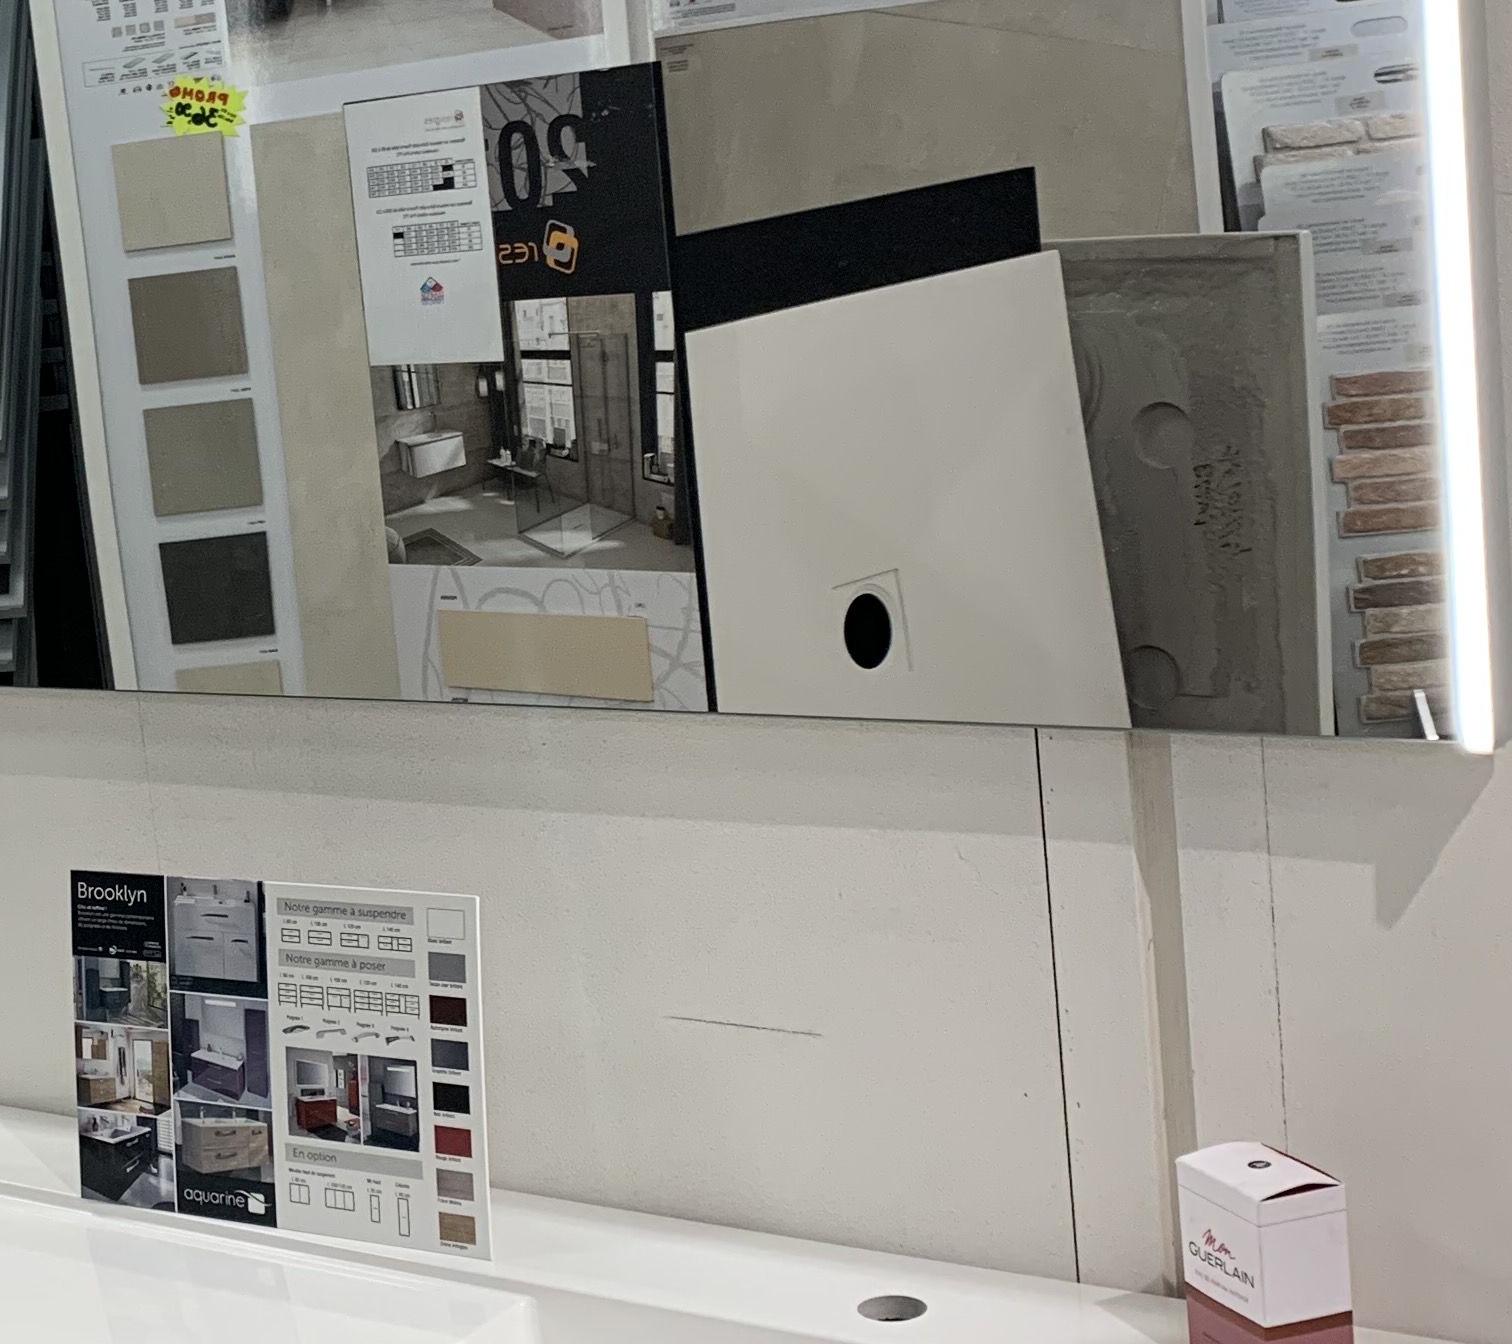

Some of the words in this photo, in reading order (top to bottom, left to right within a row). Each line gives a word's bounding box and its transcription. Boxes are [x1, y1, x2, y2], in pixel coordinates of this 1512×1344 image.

[77, 881, 148, 907] Brooklyn
[284, 902, 310, 913] Notre
[312, 905, 348, 917] gamme
[358, 909, 407, 921] suspendre
[286, 954, 312, 965] Notre
[314, 957, 350, 969] gamme
[359, 962, 386, 972] poser
[293, 1148, 305, 1159] En
[307, 1152, 337, 1164] option
[183, 1188, 245, 1208] aquarine
[1188, 1241, 1255, 1288] GUERLAIN
